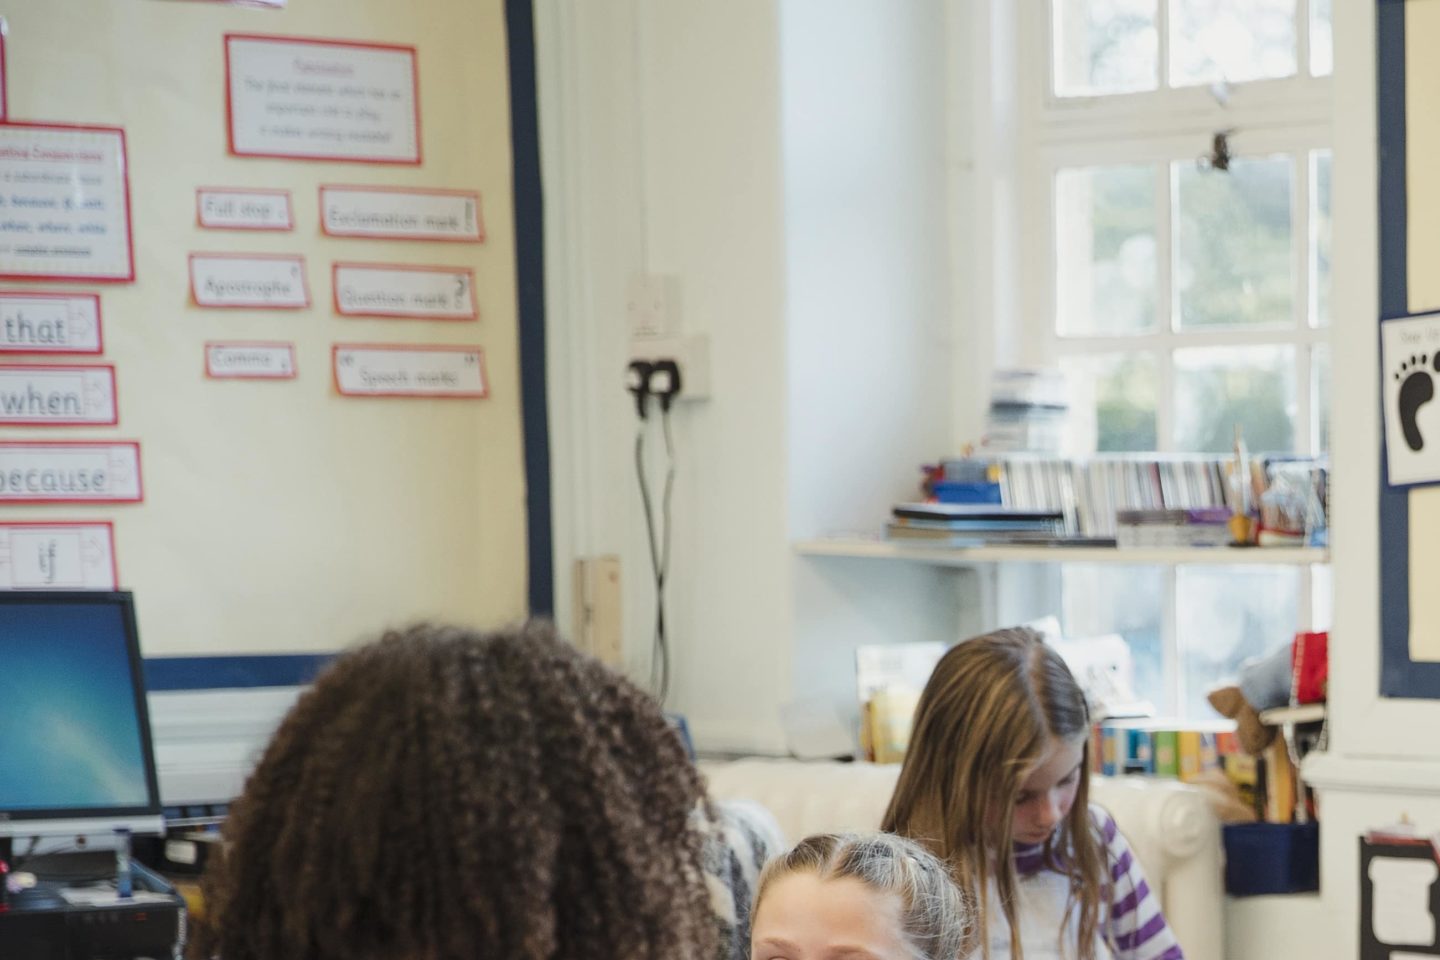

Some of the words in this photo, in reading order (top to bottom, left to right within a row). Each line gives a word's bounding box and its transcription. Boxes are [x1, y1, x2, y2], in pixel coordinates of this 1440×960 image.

[5, 310, 65, 344] that
[211, 349, 272, 368] Comma
[0, 381, 82, 415] when
[37, 539, 57, 585] if
